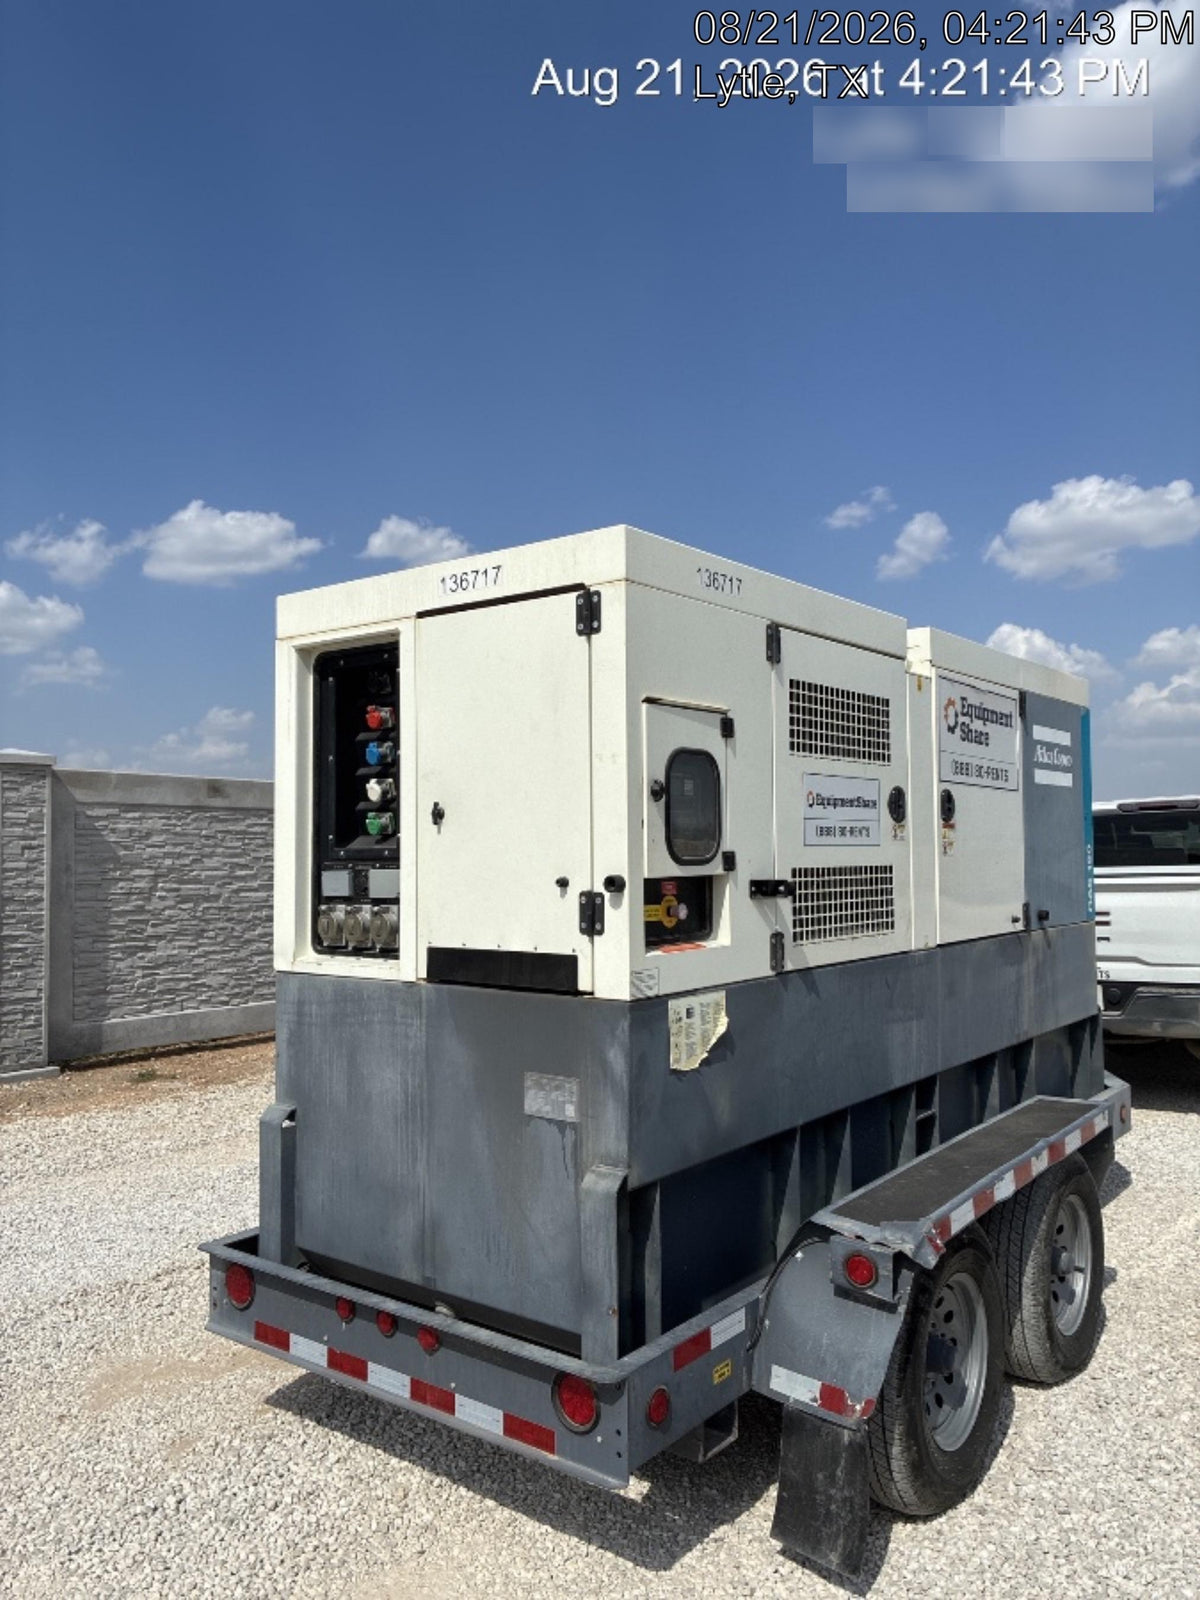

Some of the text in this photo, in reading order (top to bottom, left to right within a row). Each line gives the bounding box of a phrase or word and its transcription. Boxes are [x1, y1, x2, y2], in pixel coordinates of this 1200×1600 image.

[440, 565, 502, 594] 136717
[697, 567, 743, 596] 136717
[960, 696, 1013, 728] Equipment
[960, 721, 989, 747] Share
